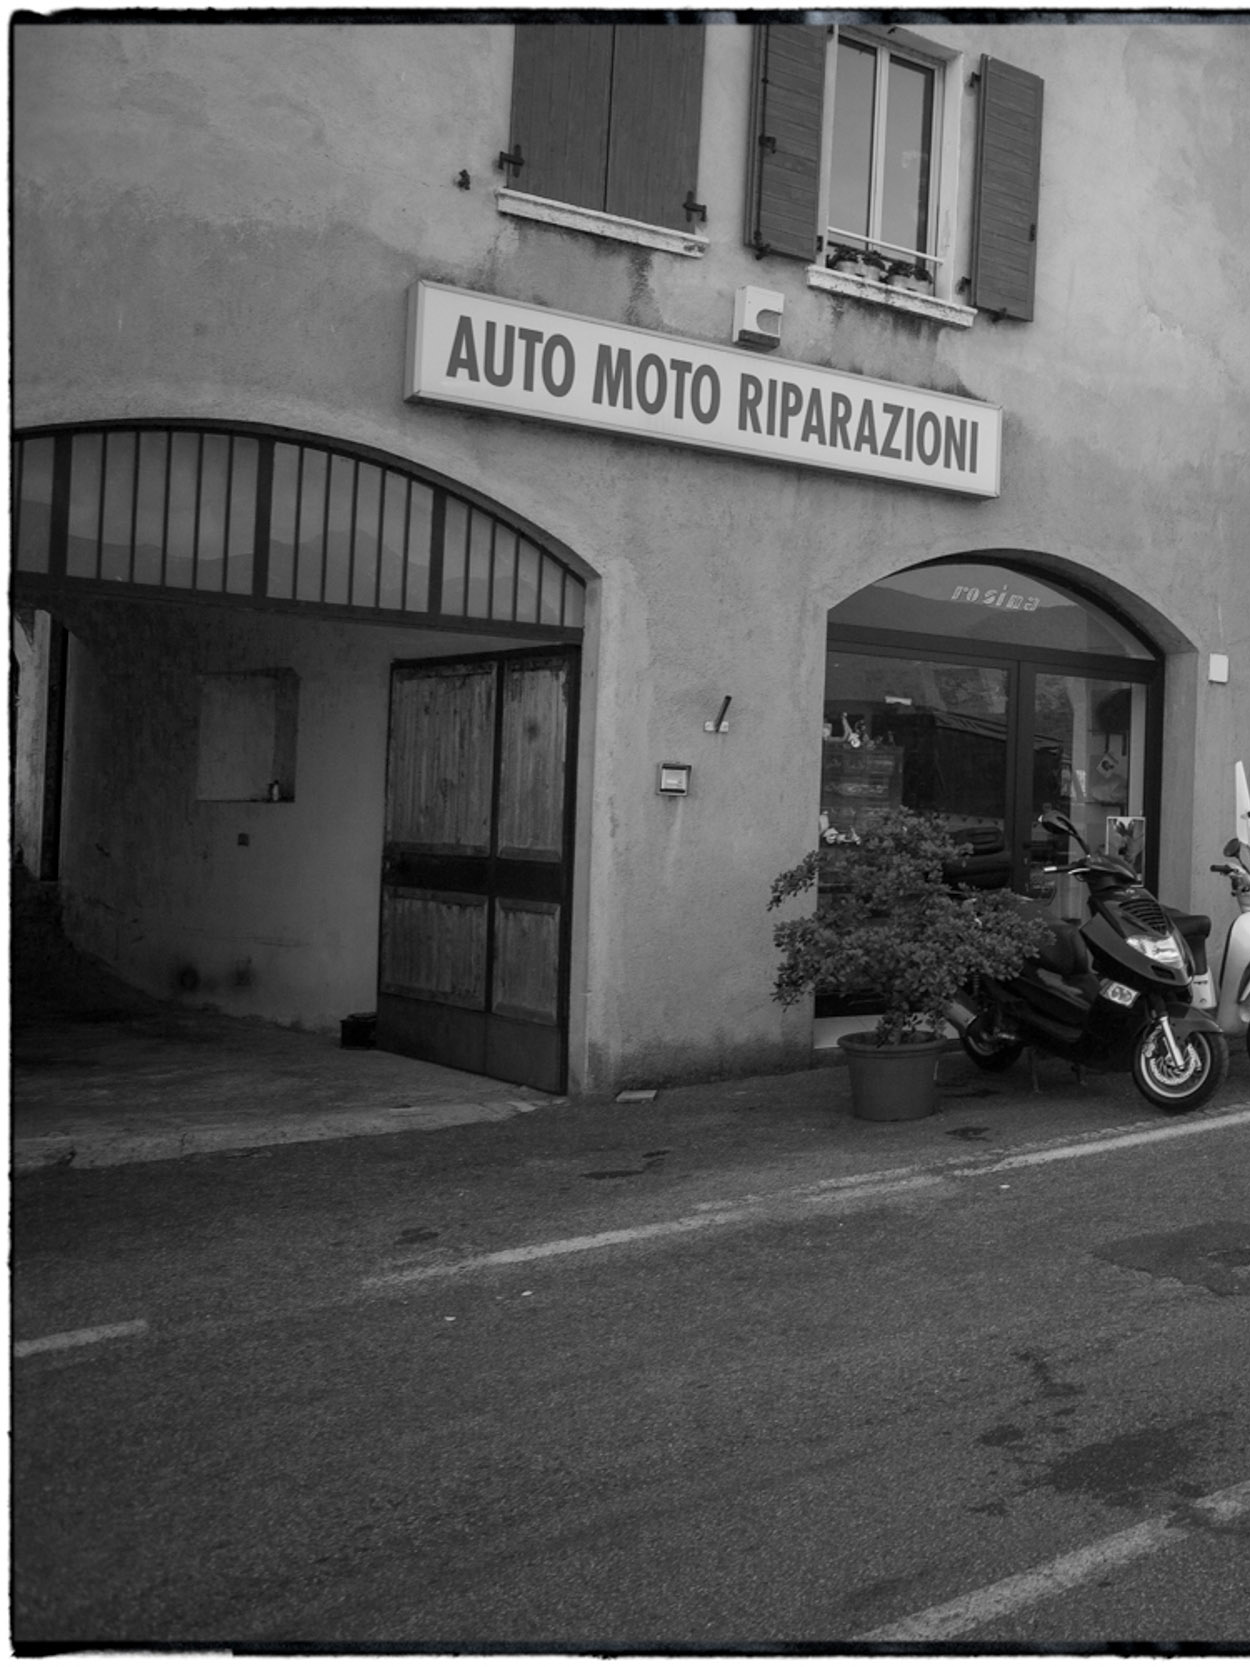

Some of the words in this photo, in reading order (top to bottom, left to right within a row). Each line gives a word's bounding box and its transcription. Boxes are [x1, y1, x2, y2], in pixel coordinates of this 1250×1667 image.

[445, 314, 577, 398] AUTO
[592, 342, 722, 425] MOTO
[737, 372, 980, 475] RIPARAZIONI
[951, 584, 1040, 611] rosina
